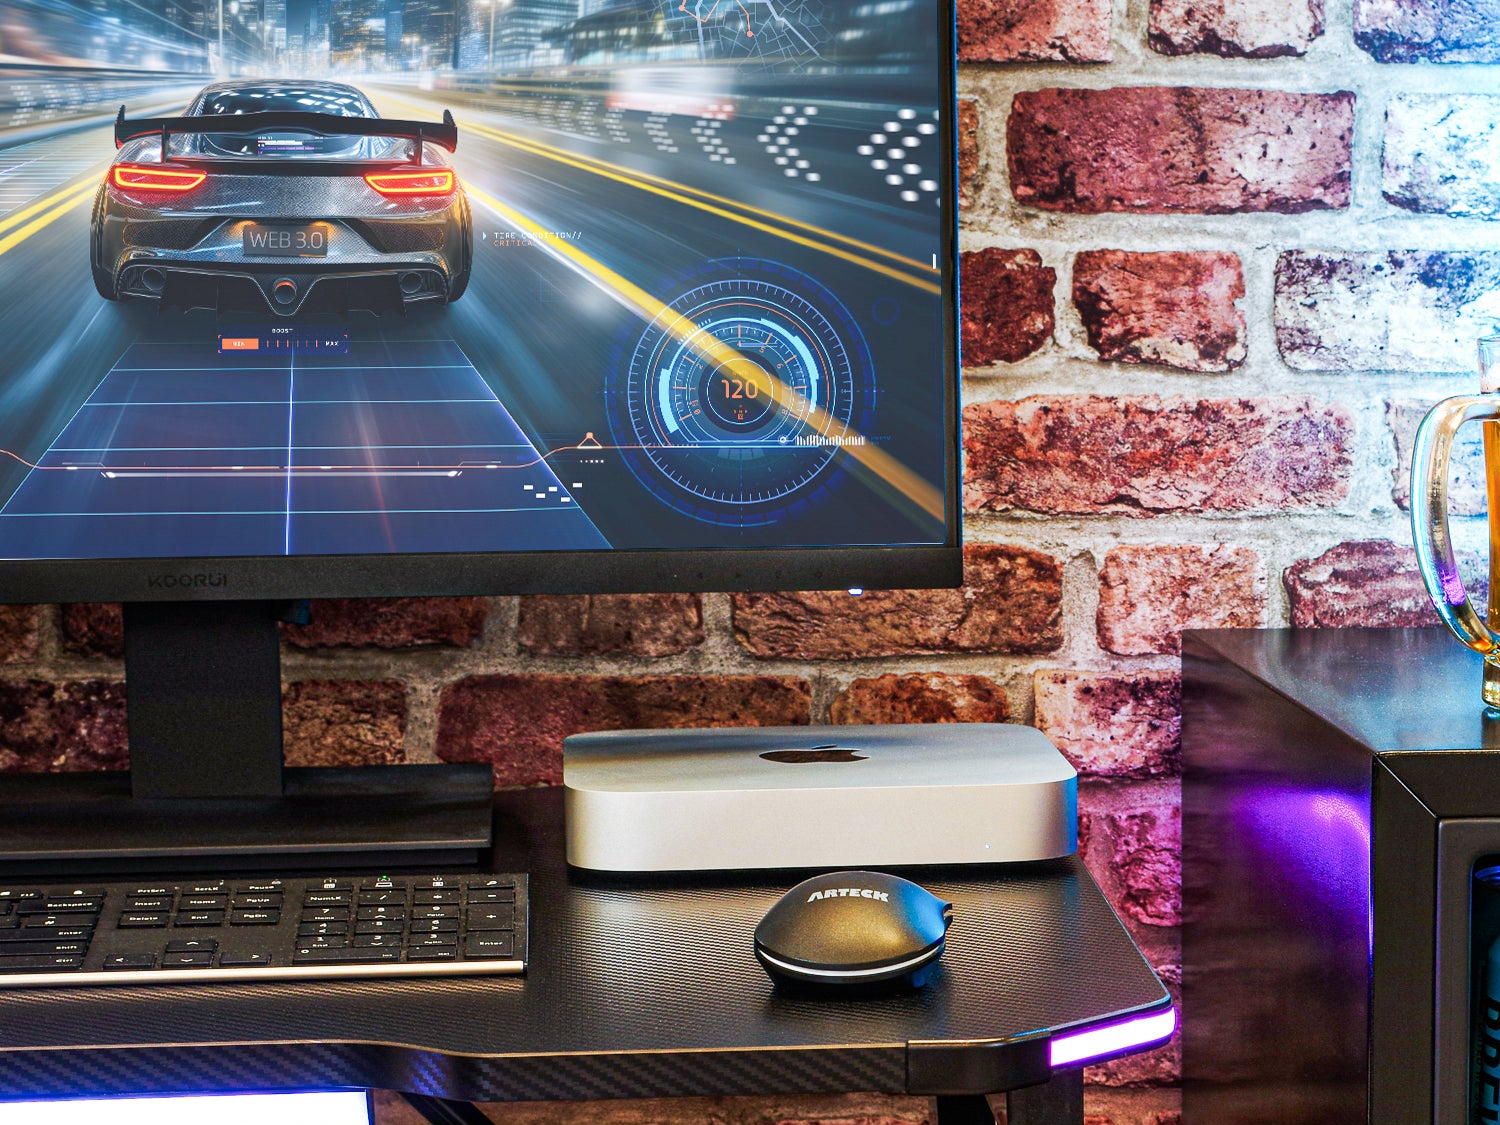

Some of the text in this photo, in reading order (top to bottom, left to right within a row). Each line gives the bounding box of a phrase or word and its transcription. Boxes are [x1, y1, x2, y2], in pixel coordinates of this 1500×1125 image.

[250, 231, 323, 249] WEB 3.0
[721, 379, 759, 399] 120
[807, 888, 889, 902] ARTECK
